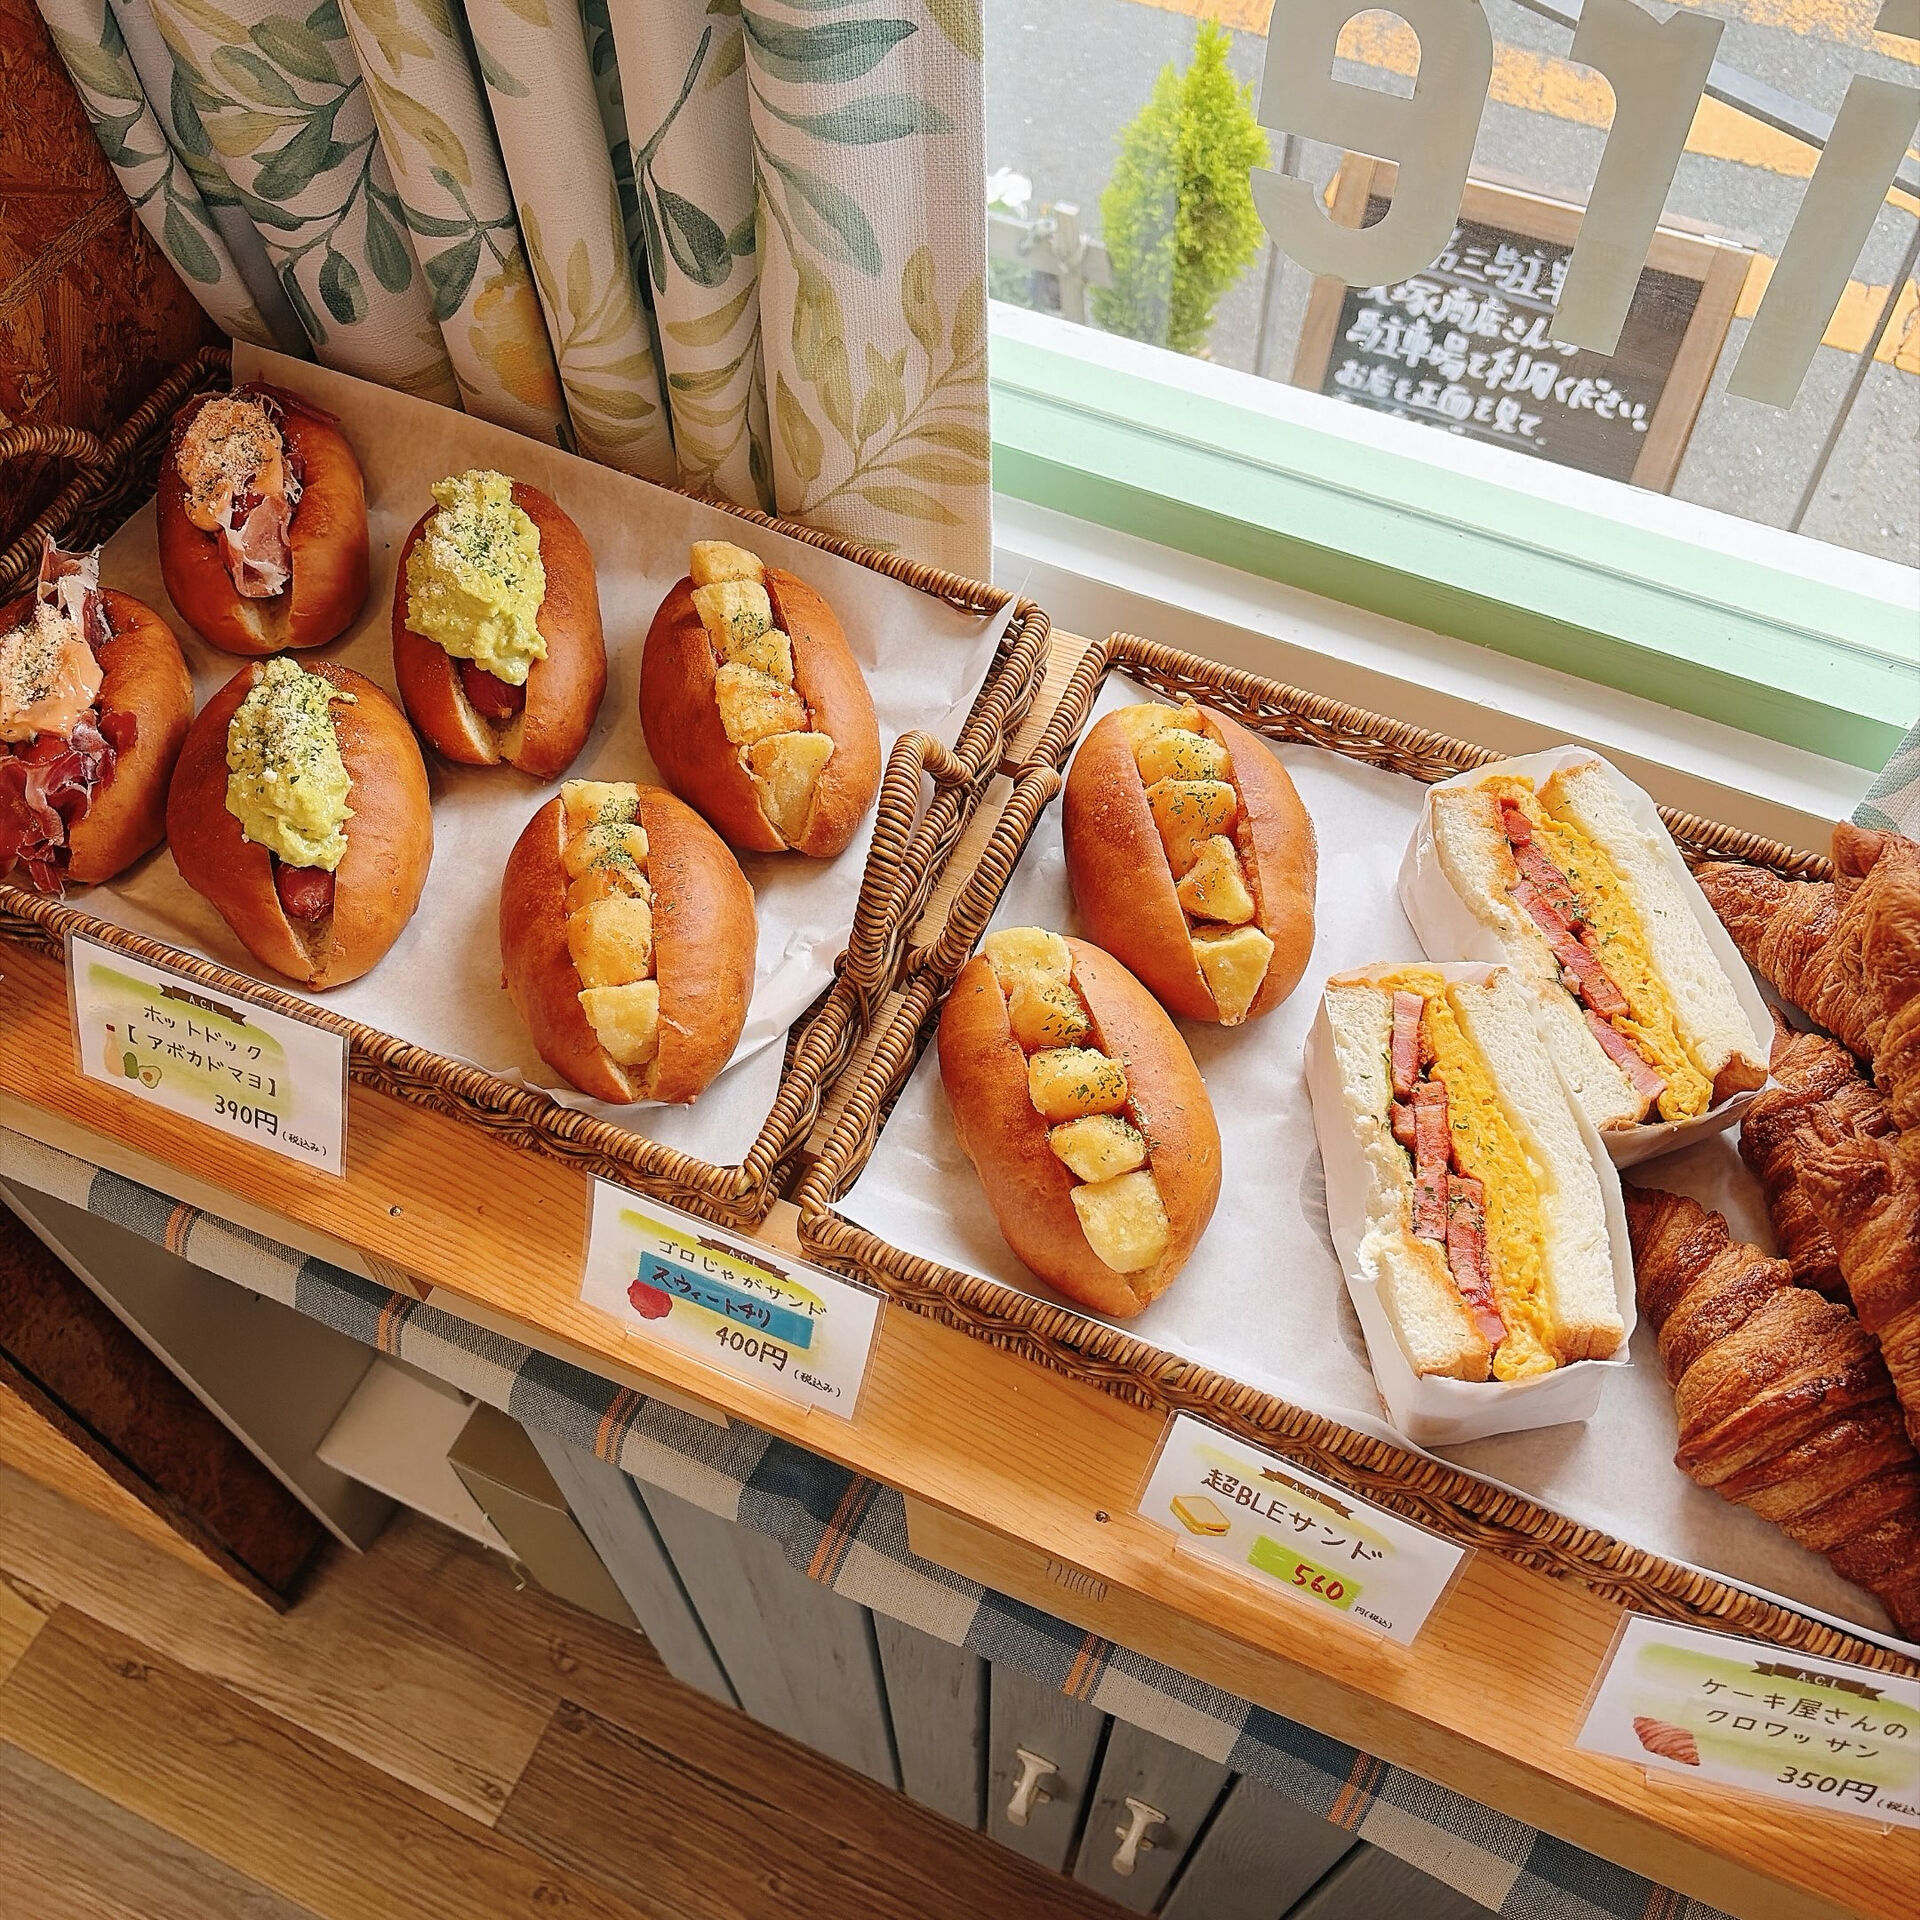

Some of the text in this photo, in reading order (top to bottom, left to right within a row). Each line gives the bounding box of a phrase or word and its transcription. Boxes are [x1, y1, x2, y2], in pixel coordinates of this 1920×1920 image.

[126, 1024, 277, 1097] 【アボカドマヨ】
[143, 1005, 262, 1059] ホットドック
[214, 1094, 328, 1156] 390円 (税込み)
[651, 1265, 772, 1329] スウィートチリ
[658, 1239, 828, 1317] ゴロじゃがサンド
[715, 1326, 842, 1397] 400円 (税込み)
[1200, 1468, 1383, 1562] 超BLEサンド
[1291, 1564, 1345, 1601] 560
[1701, 1678, 1908, 1740] ケーキ屋さんの
[1706, 1709, 1880, 1759] クロワッサン
[1776, 1766, 1920, 1816] 350円 (税込
